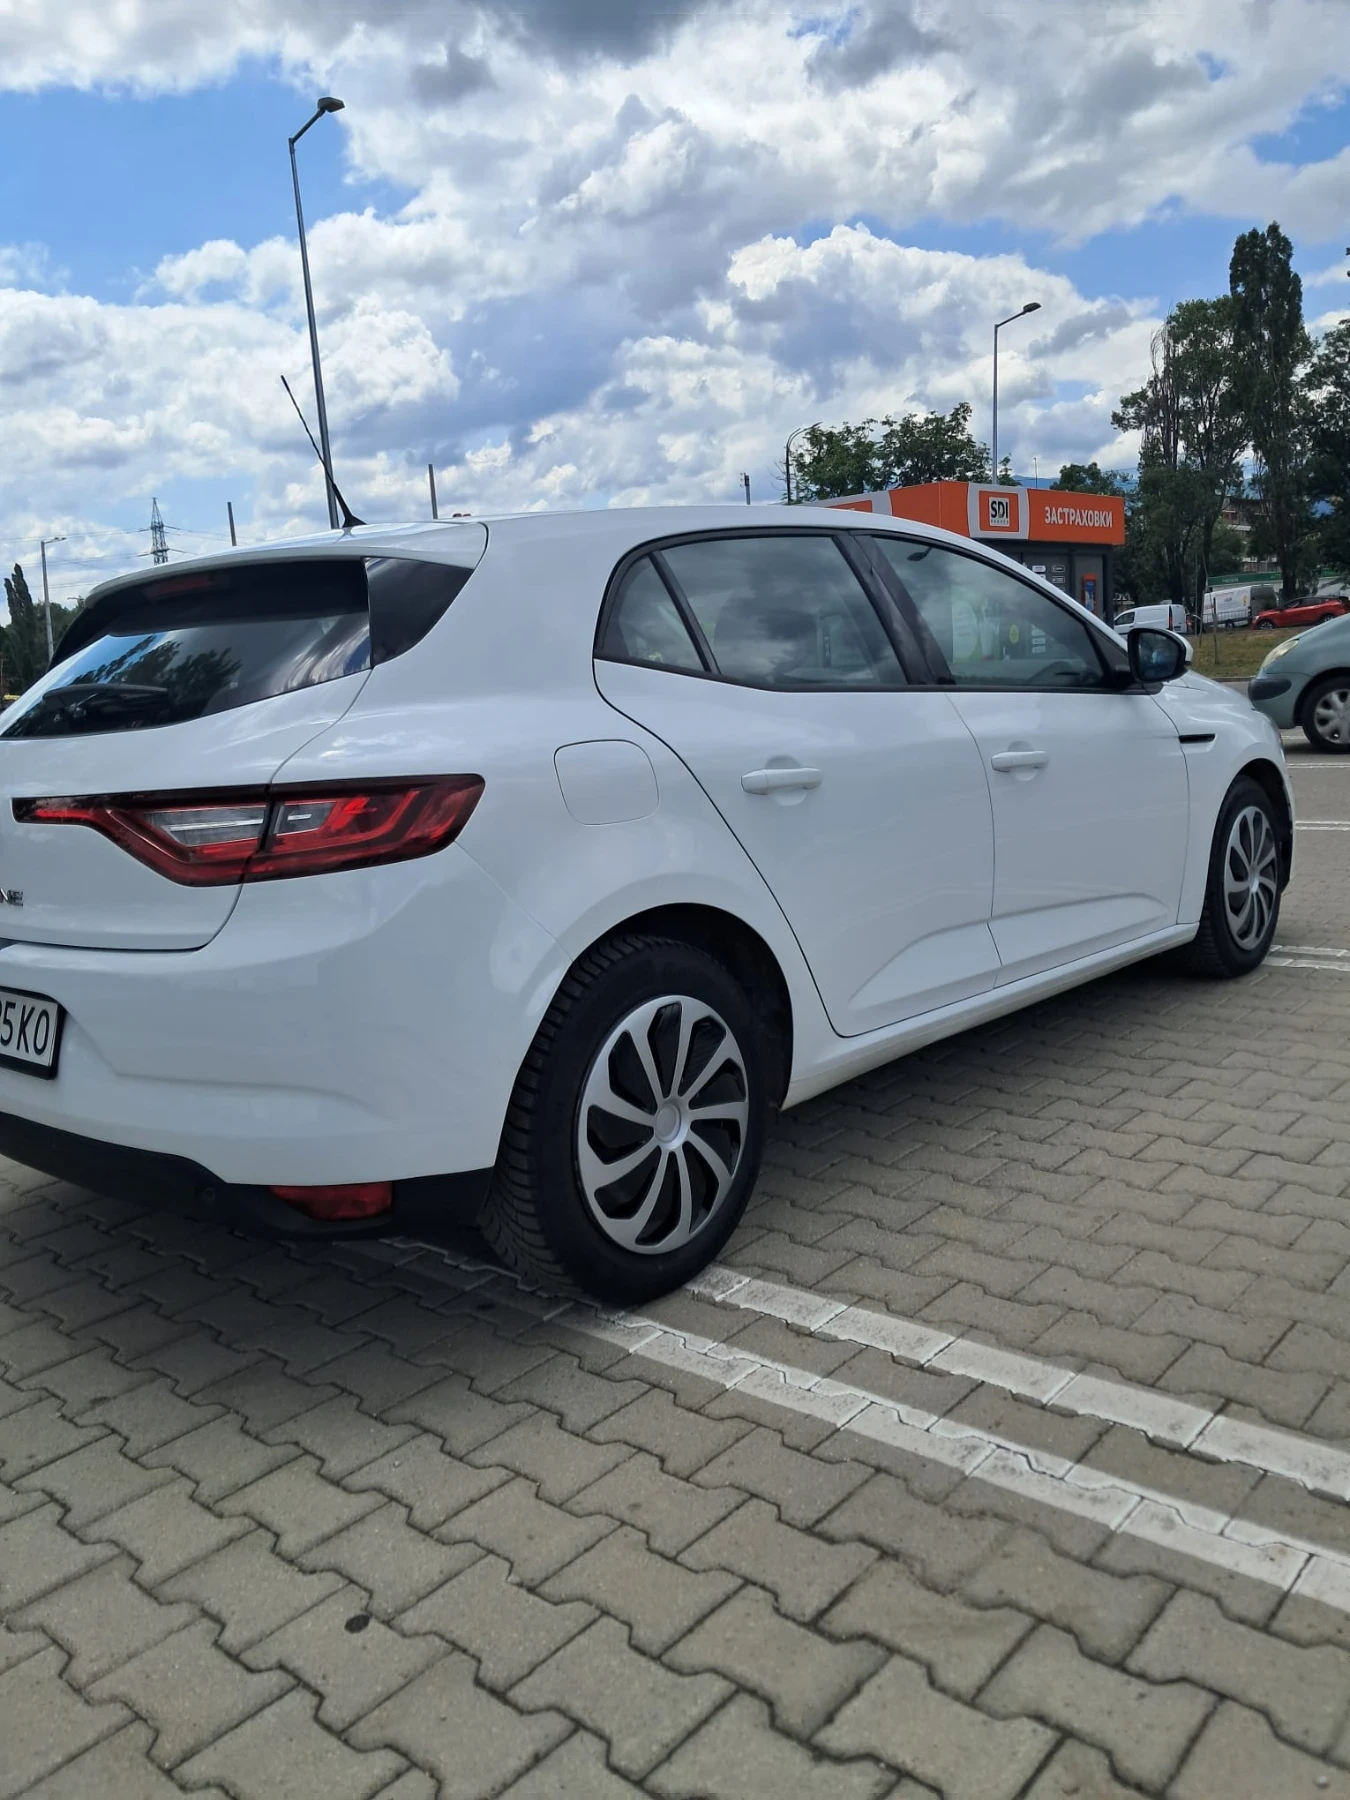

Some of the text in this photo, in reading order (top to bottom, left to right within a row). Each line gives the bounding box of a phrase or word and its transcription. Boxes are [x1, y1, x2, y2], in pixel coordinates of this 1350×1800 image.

[991, 501, 1008, 518] SDI
[1045, 506, 1113, 528] ЗАСТРАХОВКИ
[0, 1001, 50, 1056] 5KO
